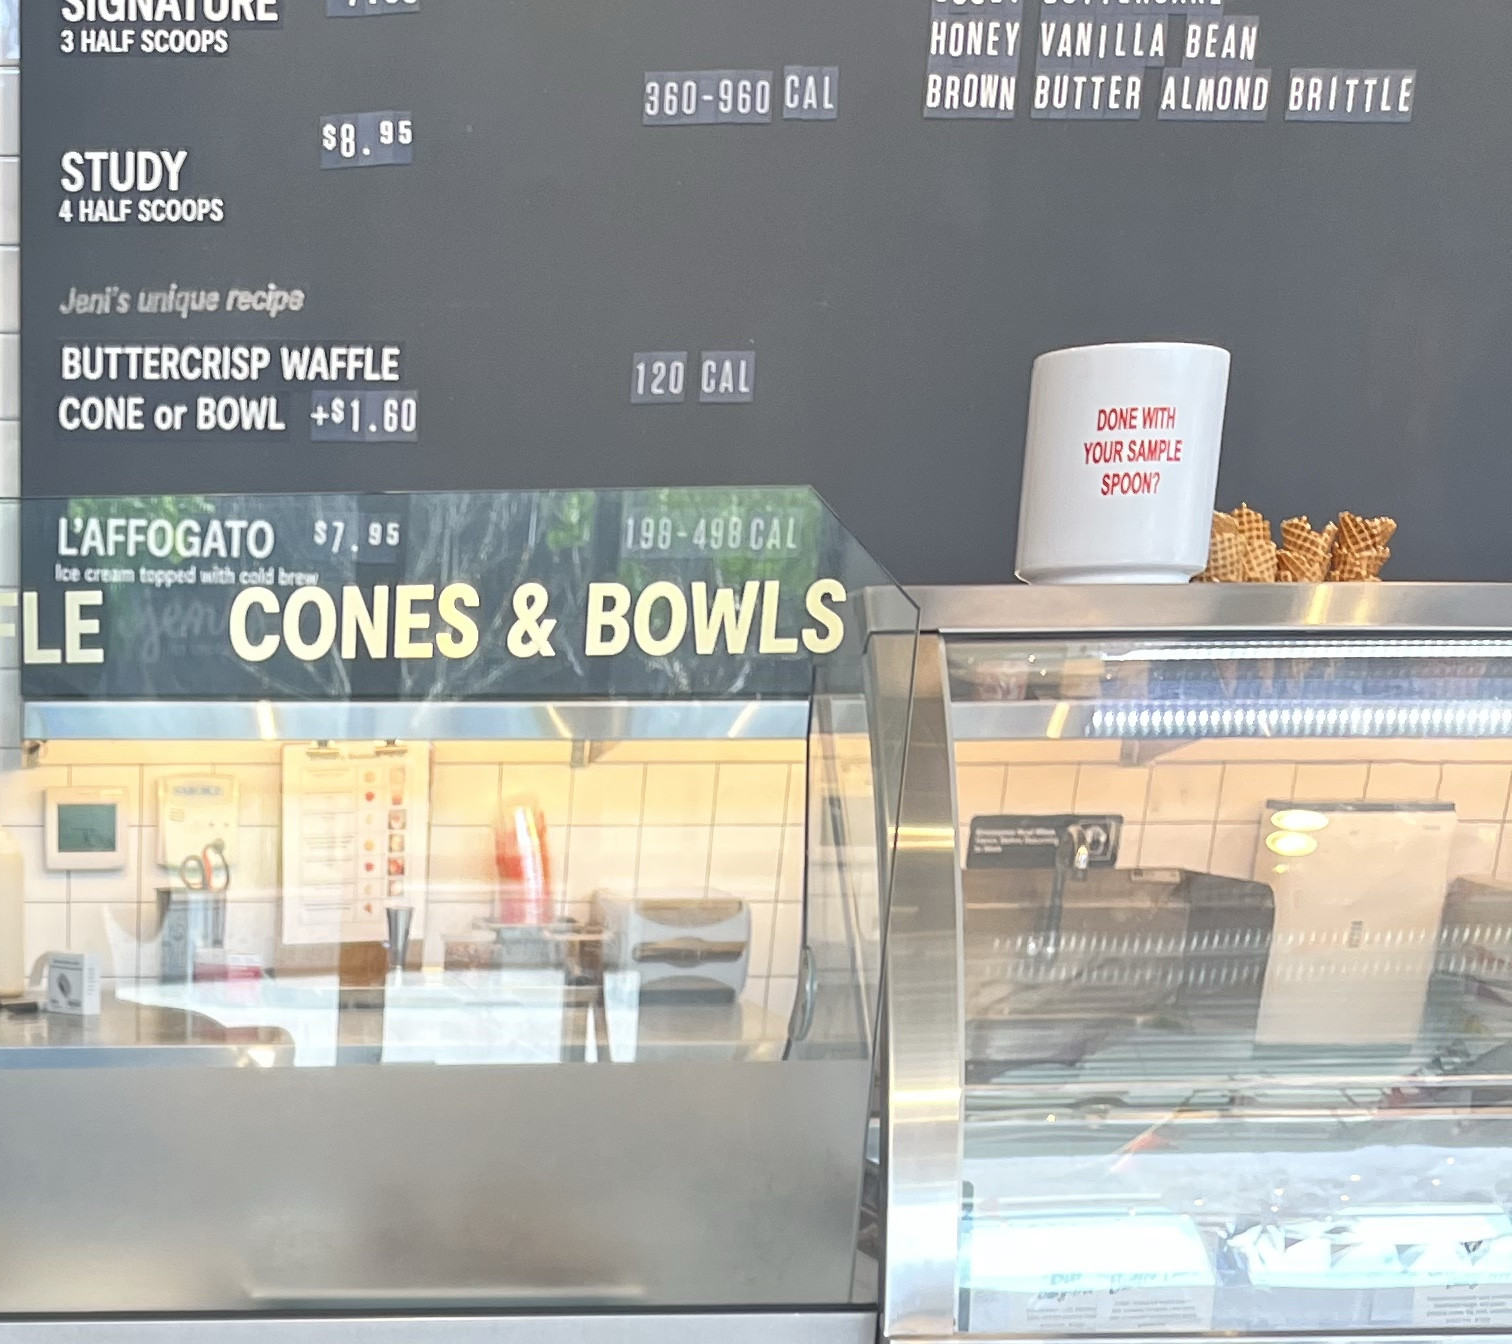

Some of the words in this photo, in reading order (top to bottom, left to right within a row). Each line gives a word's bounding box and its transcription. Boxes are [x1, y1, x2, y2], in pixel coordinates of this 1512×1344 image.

[60, 30, 74, 53] 3
[80, 29, 135, 53] HALF
[140, 29, 229, 54] SCOOPS
[930, 21, 1020, 57] HONEY
[1041, 22, 1165, 58] VANILLA
[1186, 24, 1258, 61] BEAN
[643, 79, 771, 117] 360-960
[784, 75, 836, 111] CAL
[926, 74, 1016, 111] BROWN
[1034, 74, 1141, 111] BUTTER
[1161, 75, 1268, 112] ALMOND
[1289, 77, 1413, 113] BRITTLE
[322, 119, 414, 159] $8.95
[60, 150, 189, 193] STUDY
[58, 200, 74, 223] 4
[79, 200, 132, 223] HALF
[137, 200, 224, 224] SCOOPS
[58, 284, 131, 316] Jeni's
[137, 283, 220, 319] unique
[226, 282, 305, 317] recipe
[61, 347, 271, 383] BUTTERCRISP
[280, 347, 400, 383] WAFFLE
[635, 361, 686, 396] 120
[701, 359, 752, 395] CAL
[58, 399, 145, 432] CONE
[154, 403, 189, 432] or
[196, 397, 285, 432] BOWL
[309, 397, 418, 435] +$1.60
[1097, 408, 1139, 431] DONE
[1142, 407, 1176, 429] WITH
[1084, 441, 1123, 464] YOUR
[1127, 440, 1183, 461] SAMPLE
[1101, 472, 1160, 495] SPOON?
[314, 521, 400, 552] $7.95
[749, 517, 797, 550] CAL
[55, 563, 81, 582] Ice
[84, 565, 135, 583] cream
[139, 565, 196, 588] topped
[200, 566, 236, 585] with
[239, 566, 275, 586] cold
[278, 568, 319, 587] brew
[228, 580, 480, 662] CONES
[506, 581, 558, 659] &
[584, 578, 848, 657] BOWLS
